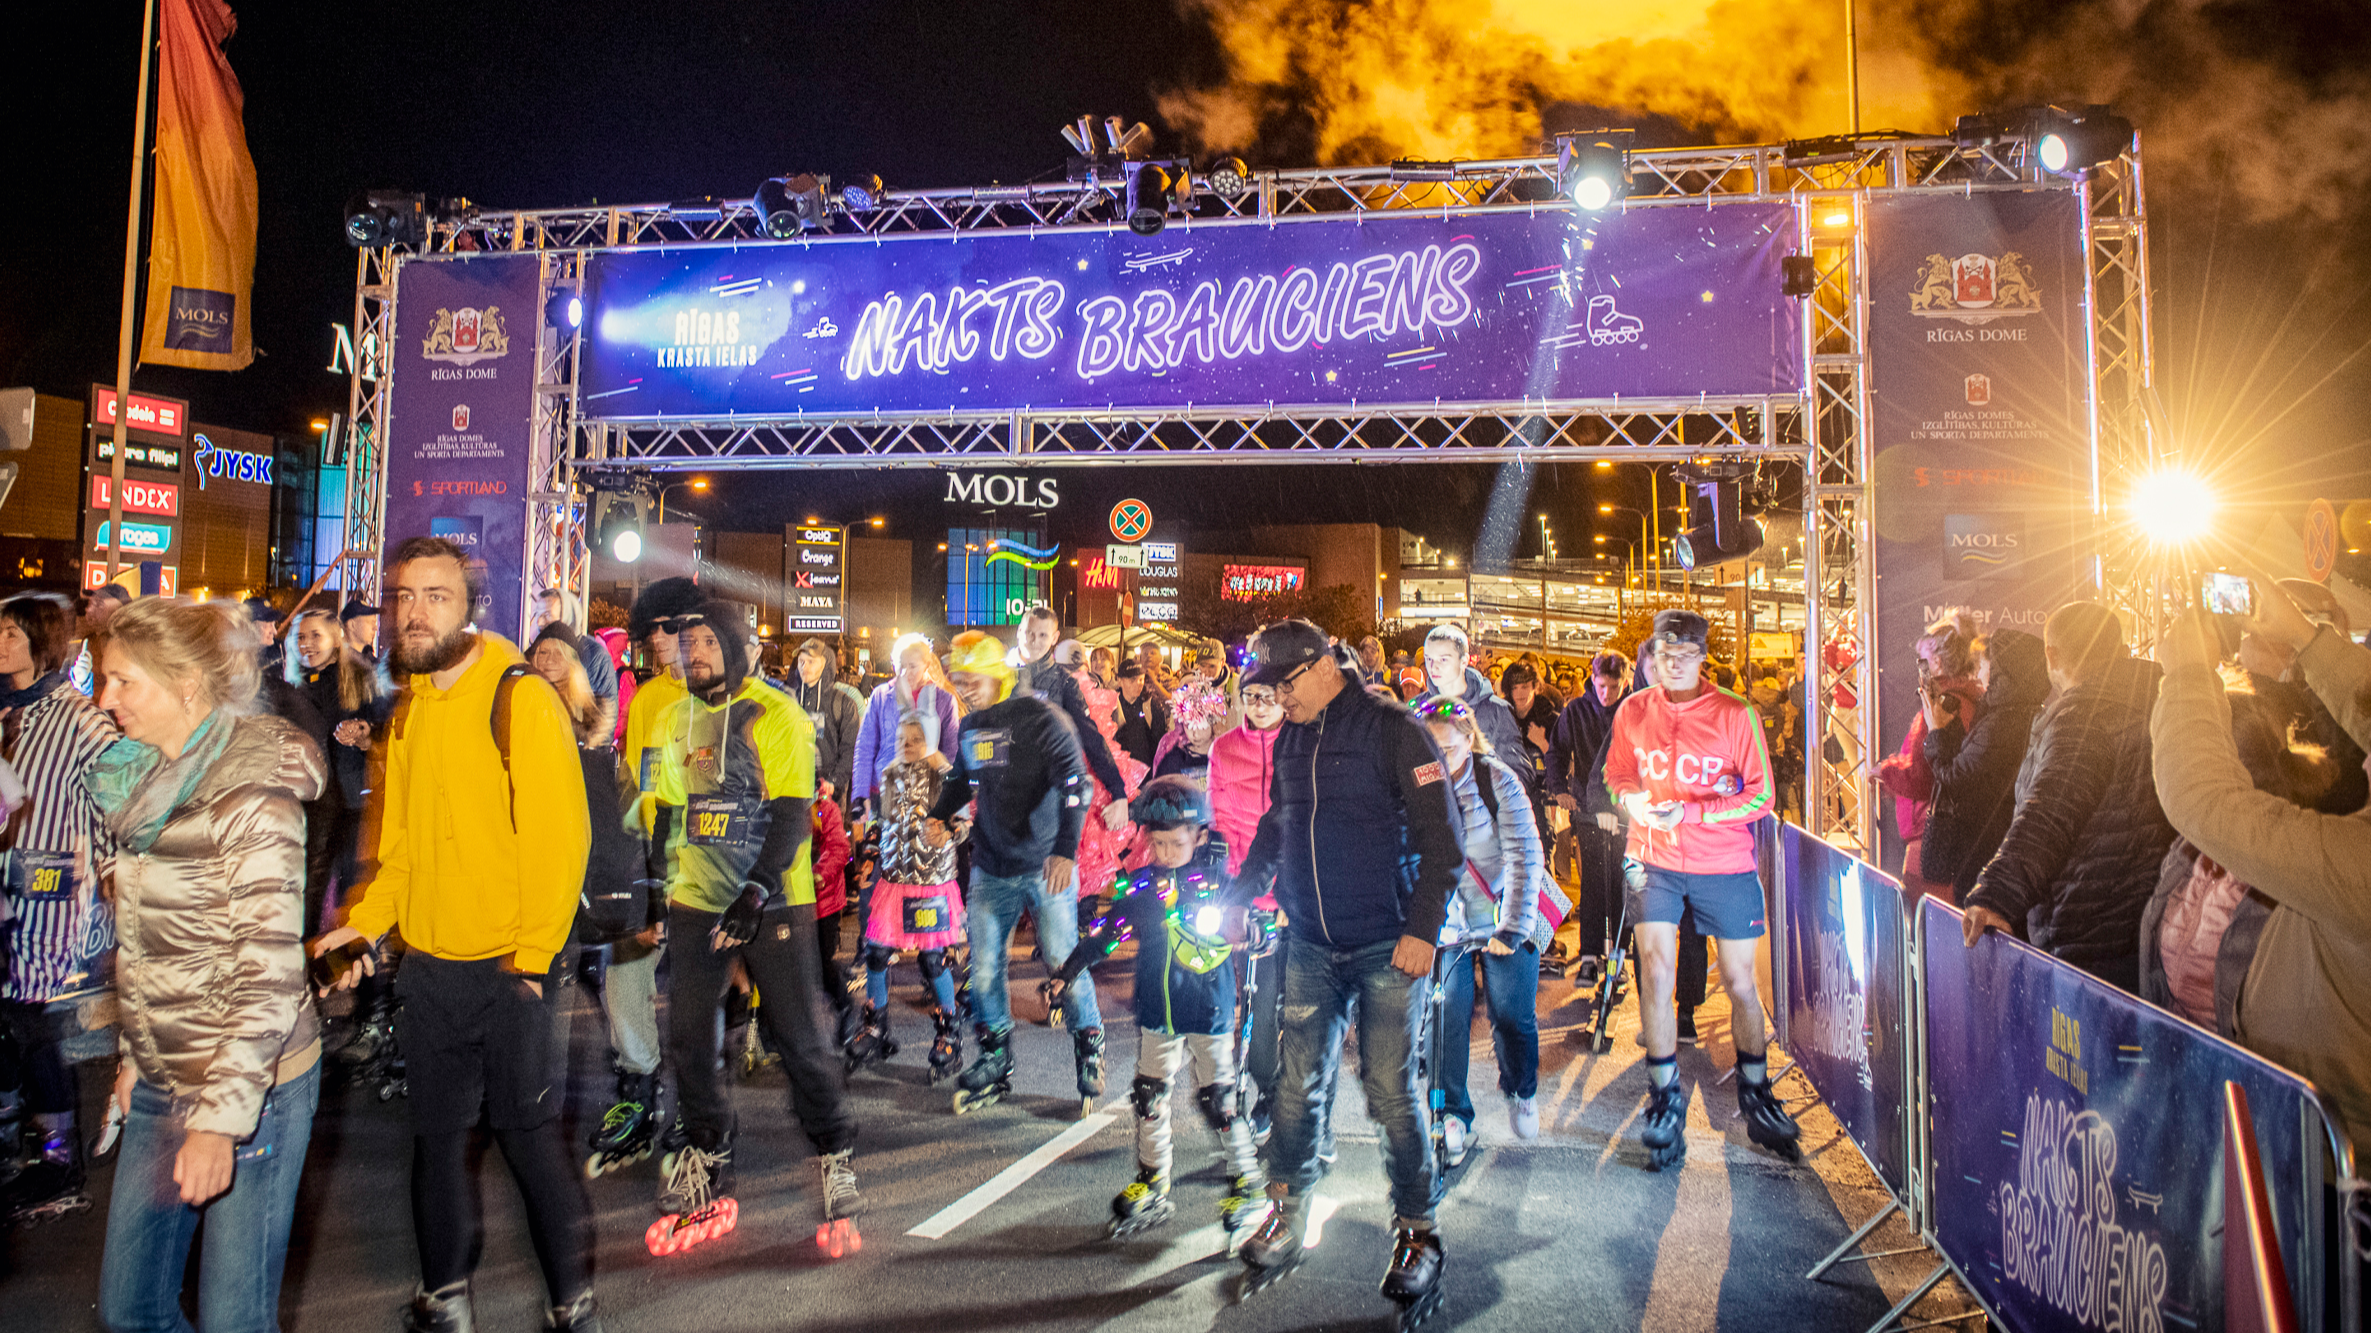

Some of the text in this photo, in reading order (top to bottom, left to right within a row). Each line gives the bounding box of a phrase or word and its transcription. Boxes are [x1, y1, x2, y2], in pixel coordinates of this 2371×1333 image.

[176, 307, 228, 325] MOLS
[844, 243, 1481, 381] NAKTS BRAUCIENS
[674, 308, 740, 345] RĪGAS
[1926, 328, 2027, 342] RĪGAS DOME
[657, 345, 757, 368] KRASTA IELAS
[431, 368, 497, 381] RĪGAS DOME
[1944, 411, 2015, 421] RĪGAS DOMES
[1981, 420, 2037, 430] KULTŪRAS
[1911, 430, 2050, 440] UN SPORTA DEPARTAMENTS
[414, 451, 425, 459] UN
[209, 448, 274, 485] JYSK
[101, 482, 170, 510] LNDEX
[431, 481, 507, 495] SPORTLAND
[944, 471, 1060, 508] MOLS
[120, 528, 159, 547] rogas
[1951, 533, 2018, 547] MOLS
[801, 549, 834, 567] Orange
[1118, 555, 1128, 564] 90
[1085, 557, 1119, 588] H&M
[800, 596, 833, 608] MAYA
[795, 620, 838, 628] RESERVED
[1998, 607, 2048, 625] Auto
[699, 812, 730, 837] 1247
[32, 868, 62, 892] 381
[2020, 1095, 2117, 1228] NAKTS
[2000, 1181, 2167, 1333] BRAUCIENS
